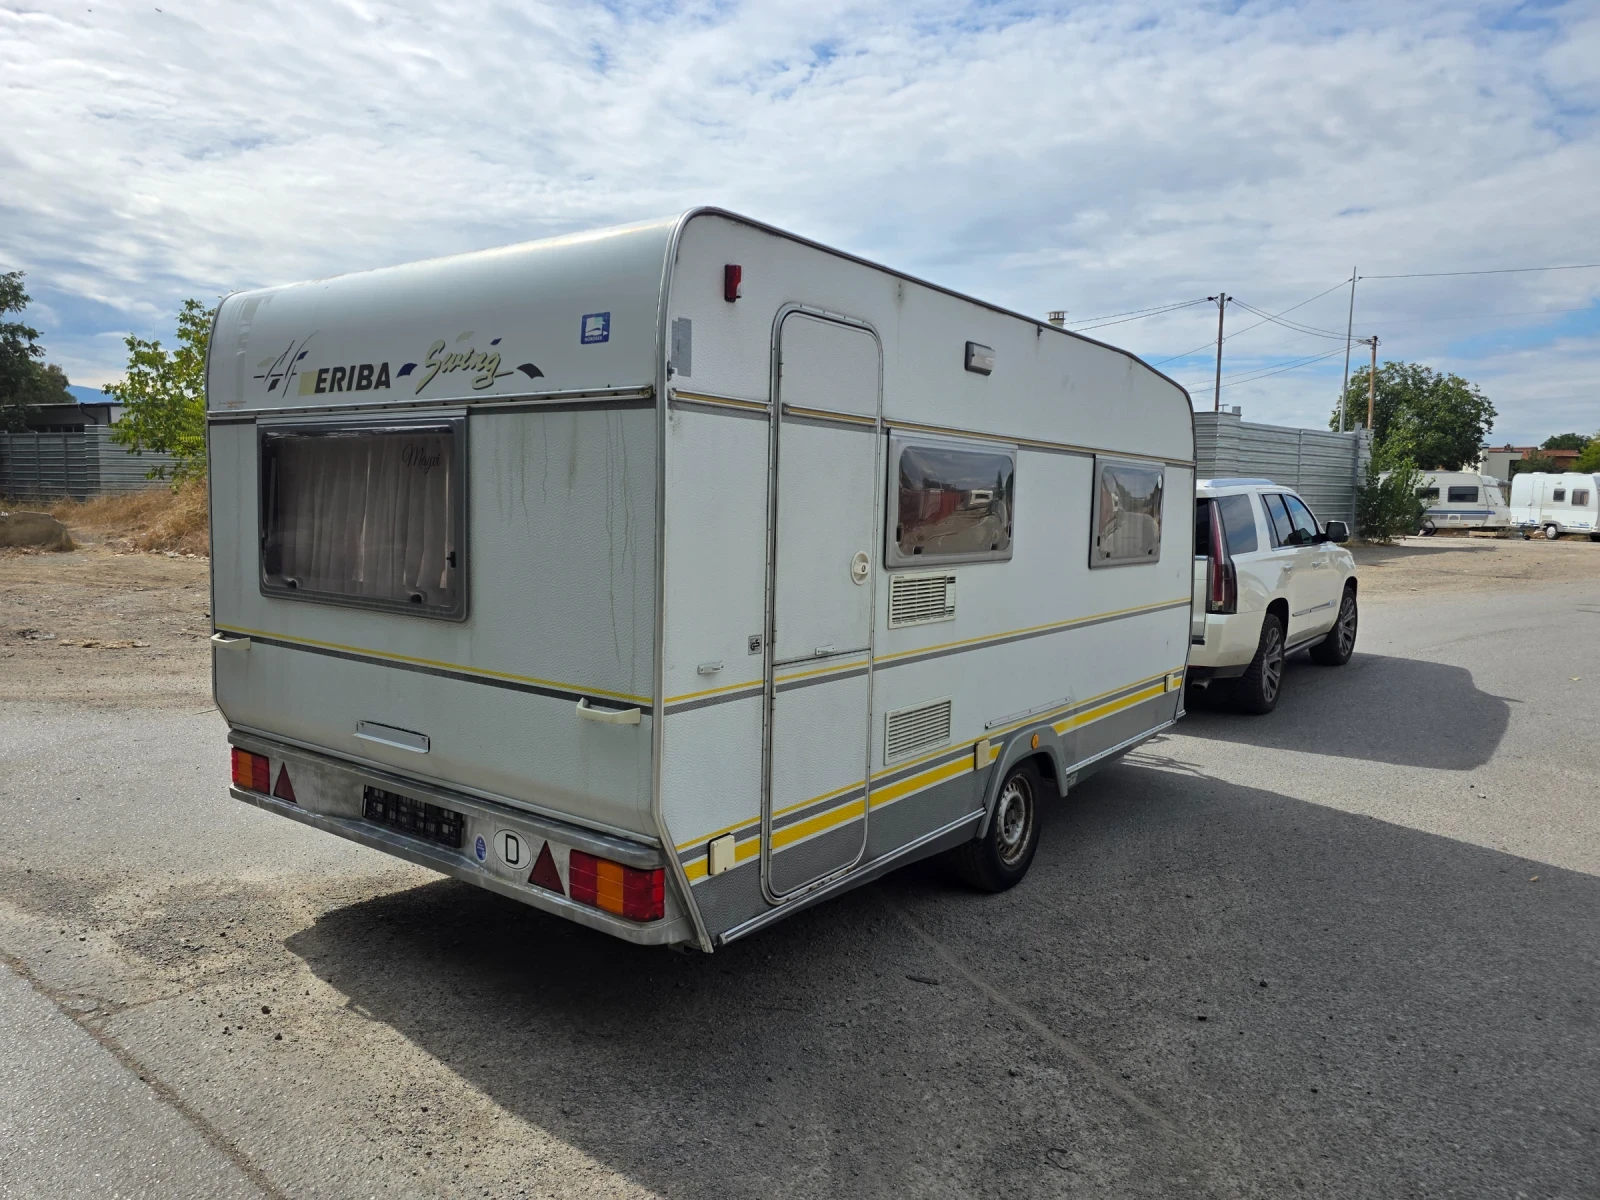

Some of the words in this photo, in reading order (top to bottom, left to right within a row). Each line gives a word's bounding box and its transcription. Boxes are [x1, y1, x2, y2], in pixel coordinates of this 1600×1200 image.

[314, 362, 391, 394] ERIBA
[415, 339, 513, 395] Swing
[505, 833, 520, 865] D
